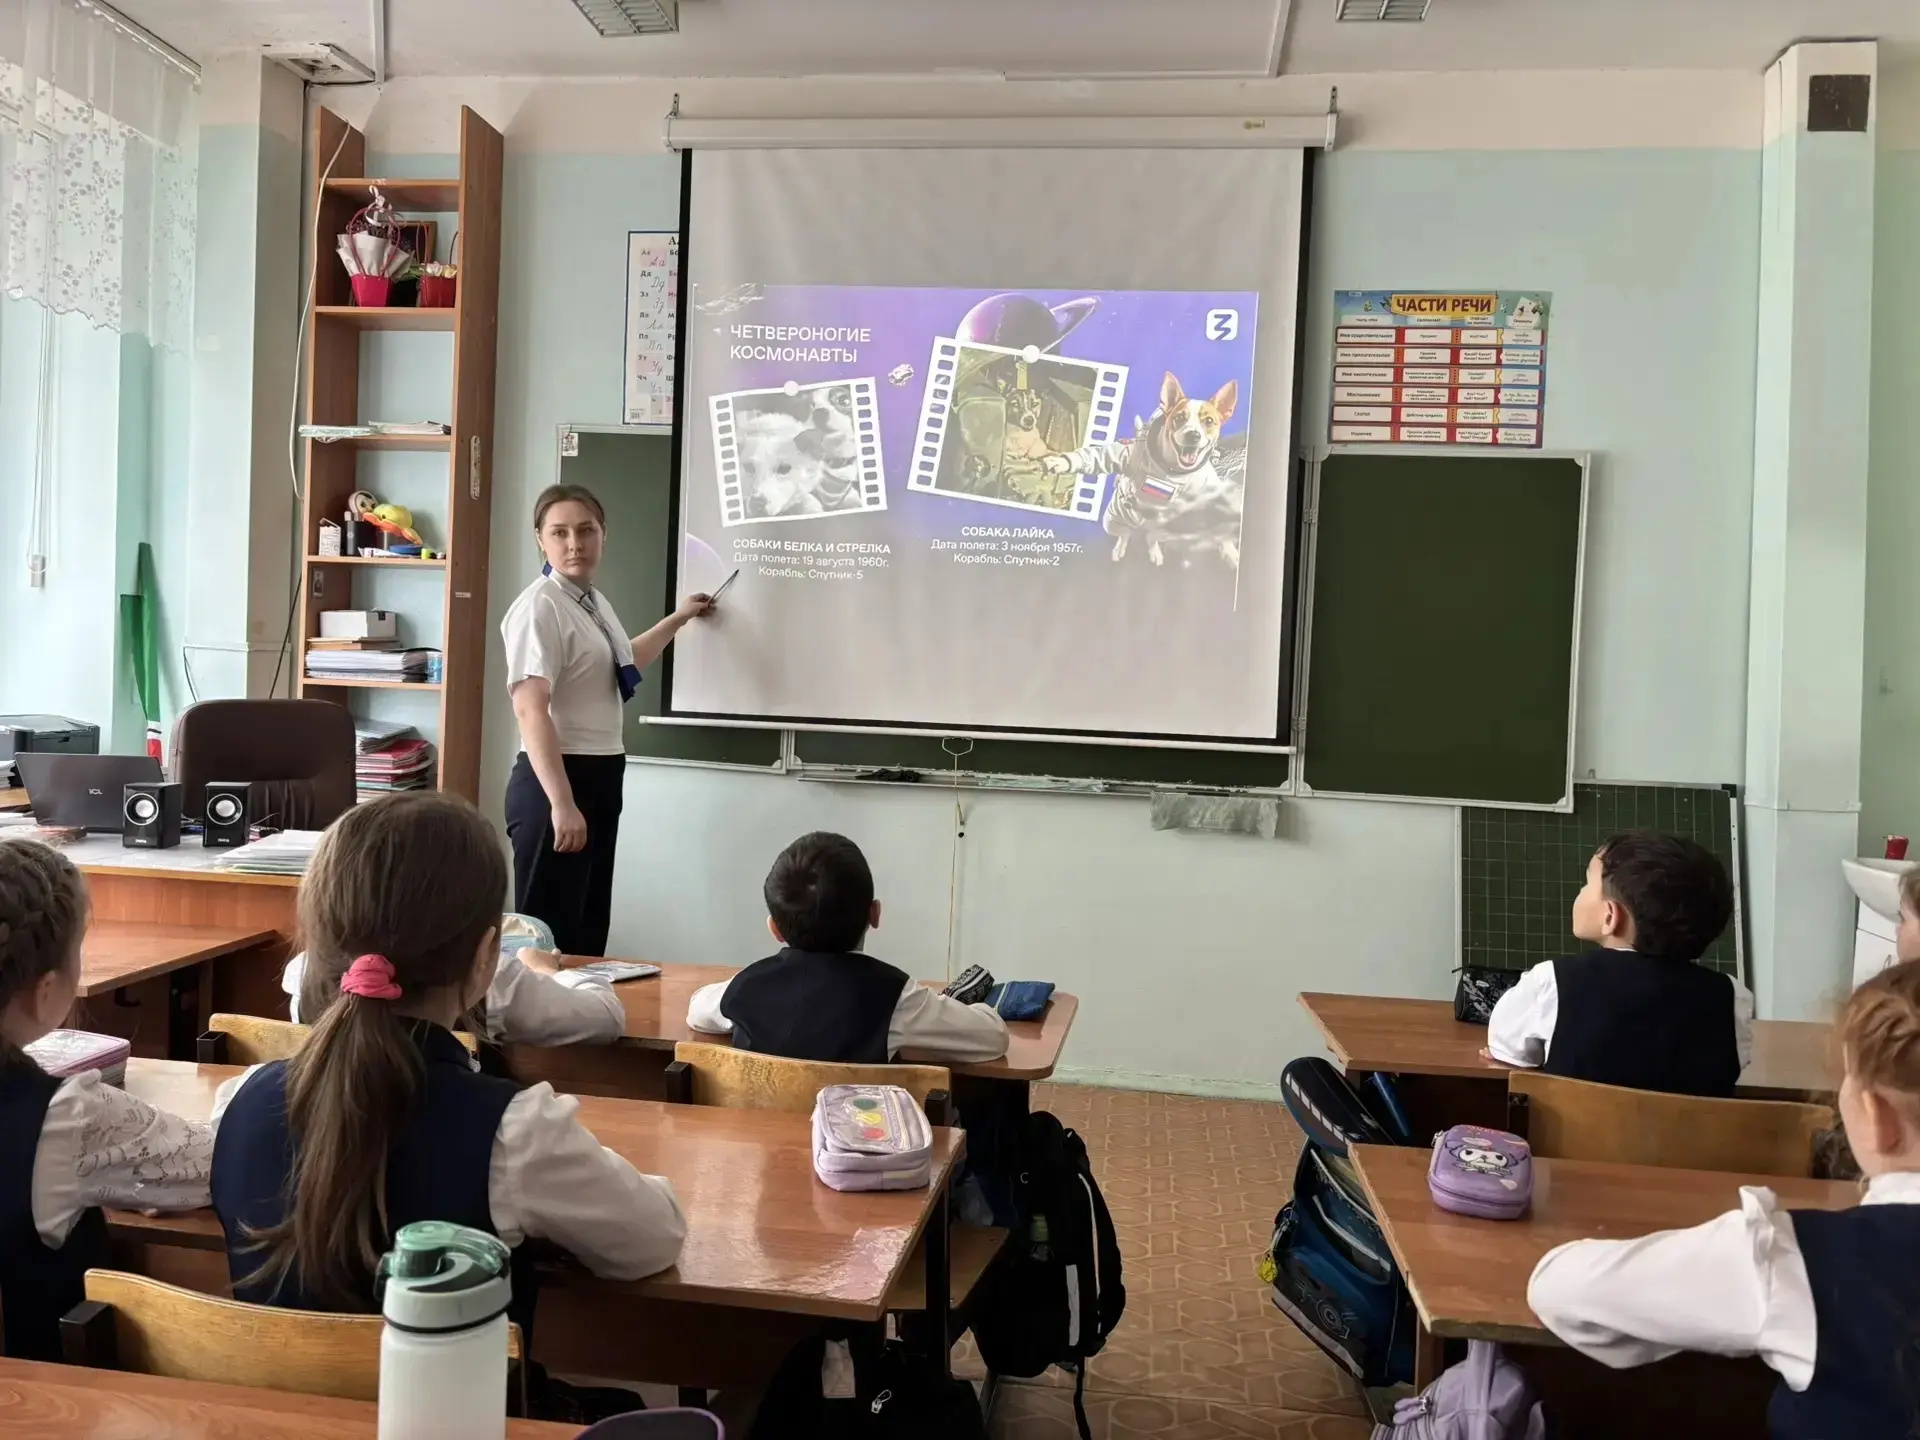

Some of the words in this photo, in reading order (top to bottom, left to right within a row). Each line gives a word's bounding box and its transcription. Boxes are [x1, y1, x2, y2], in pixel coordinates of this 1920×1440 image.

[1396, 298, 1448, 312] ЧАСТИ
[1452, 298, 1492, 312] РЕЧИ
[730, 324, 871, 342] ЧЕТВЕРОНОГИЕ
[730, 345, 857, 362] КОСМОНАВТЫ
[962, 526, 1010, 537] СОБАКА
[1012, 526, 1054, 538] ЛАЙКА
[734, 539, 781, 550] СОБАКИ
[784, 541, 824, 552] БЕЛКА
[826, 544, 834, 552] И
[836, 543, 891, 554] СТРЕЛКА
[931, 539, 957, 550] Дата
[960, 542, 999, 551] полета:
[1002, 541, 1008, 551] 3
[1010, 543, 1050, 554] ноября
[1053, 543, 1084, 553] 1957г.
[732, 552, 758, 562] Дата
[762, 555, 800, 564] полета:
[802, 556, 814, 565] 19
[816, 558, 854, 568] августа
[858, 556, 889, 567] 1960г.
[954, 553, 1002, 564] Корабль:
[1004, 554, 1060, 566] Спутник-2
[758, 566, 806, 578] Корабль:
[808, 568, 864, 580] Спутник-5
